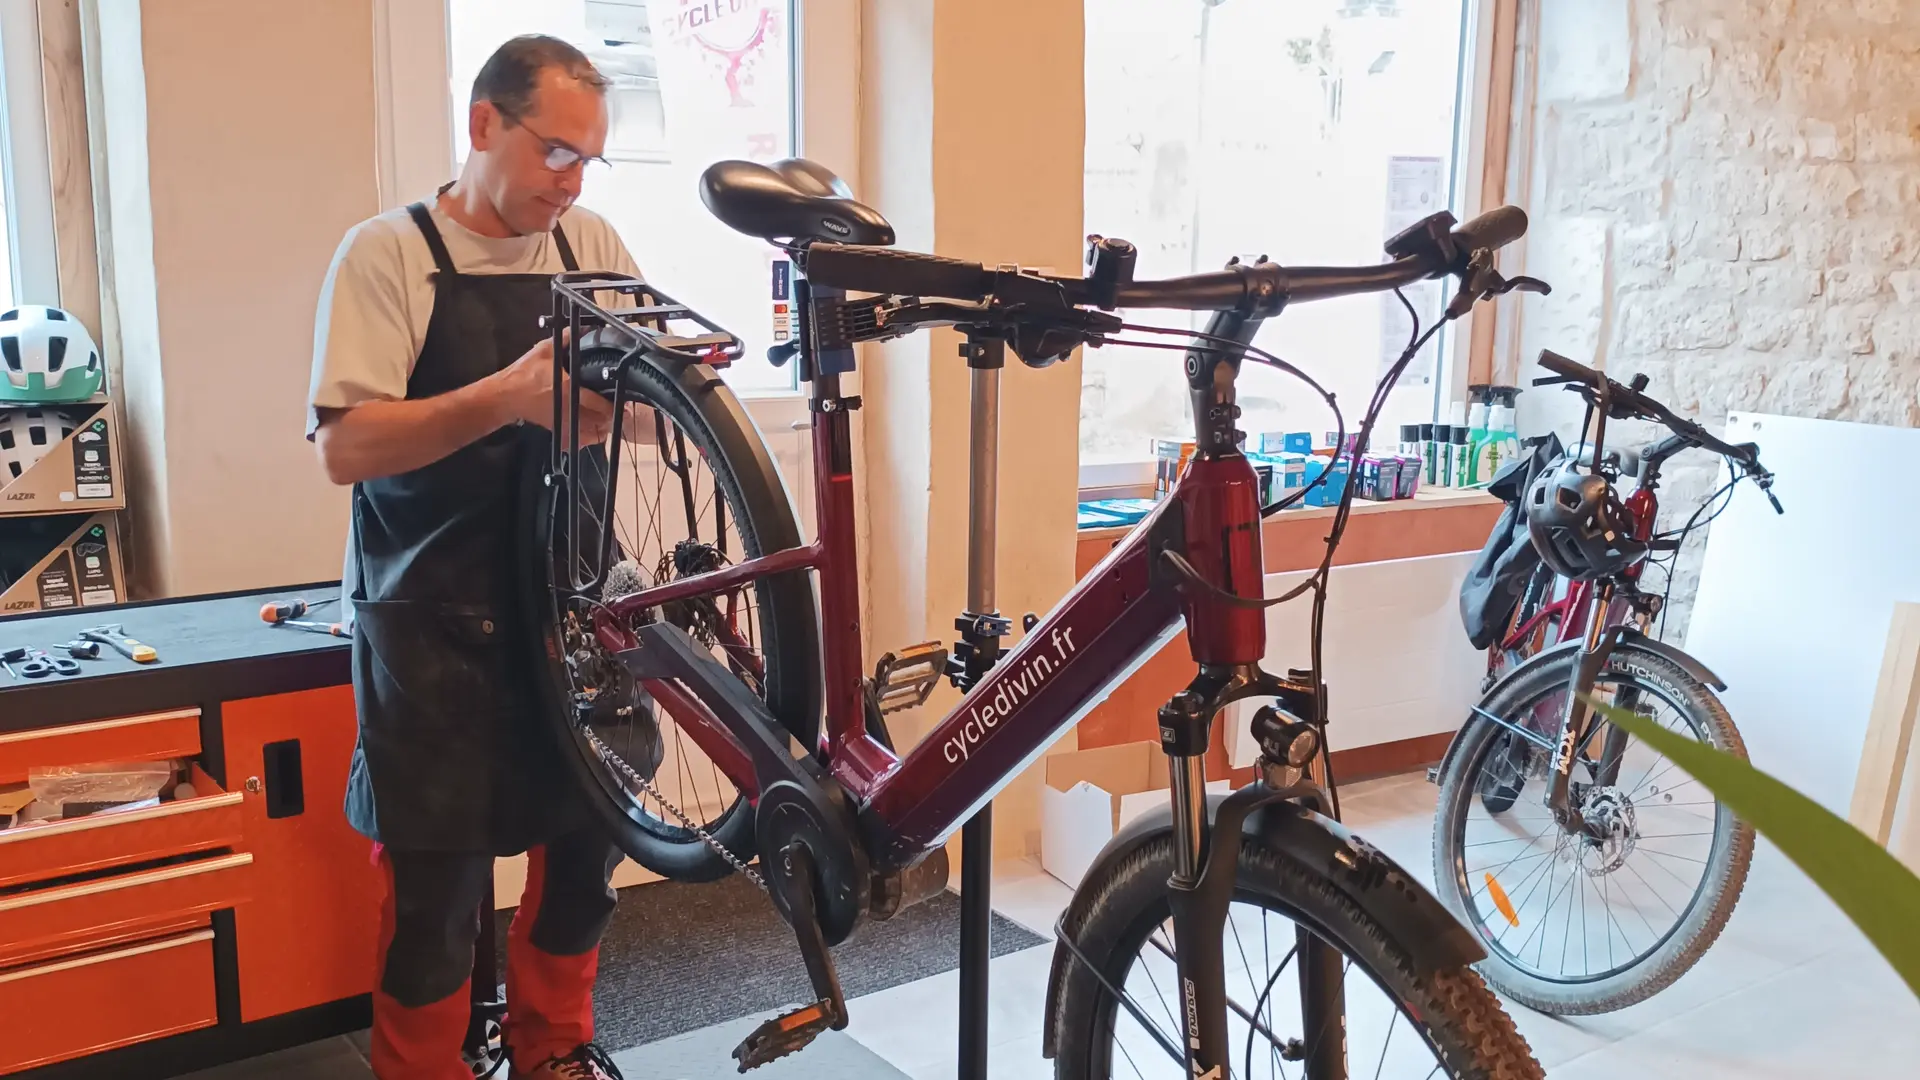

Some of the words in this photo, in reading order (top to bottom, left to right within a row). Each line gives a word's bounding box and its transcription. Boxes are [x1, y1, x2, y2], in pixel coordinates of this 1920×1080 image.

[6, 492, 36, 501] LAZER
[4, 600, 35, 610] LAZER
[943, 626, 1076, 763] cycledivin.fr
[1611, 661, 1688, 706] HUTCHINSON
